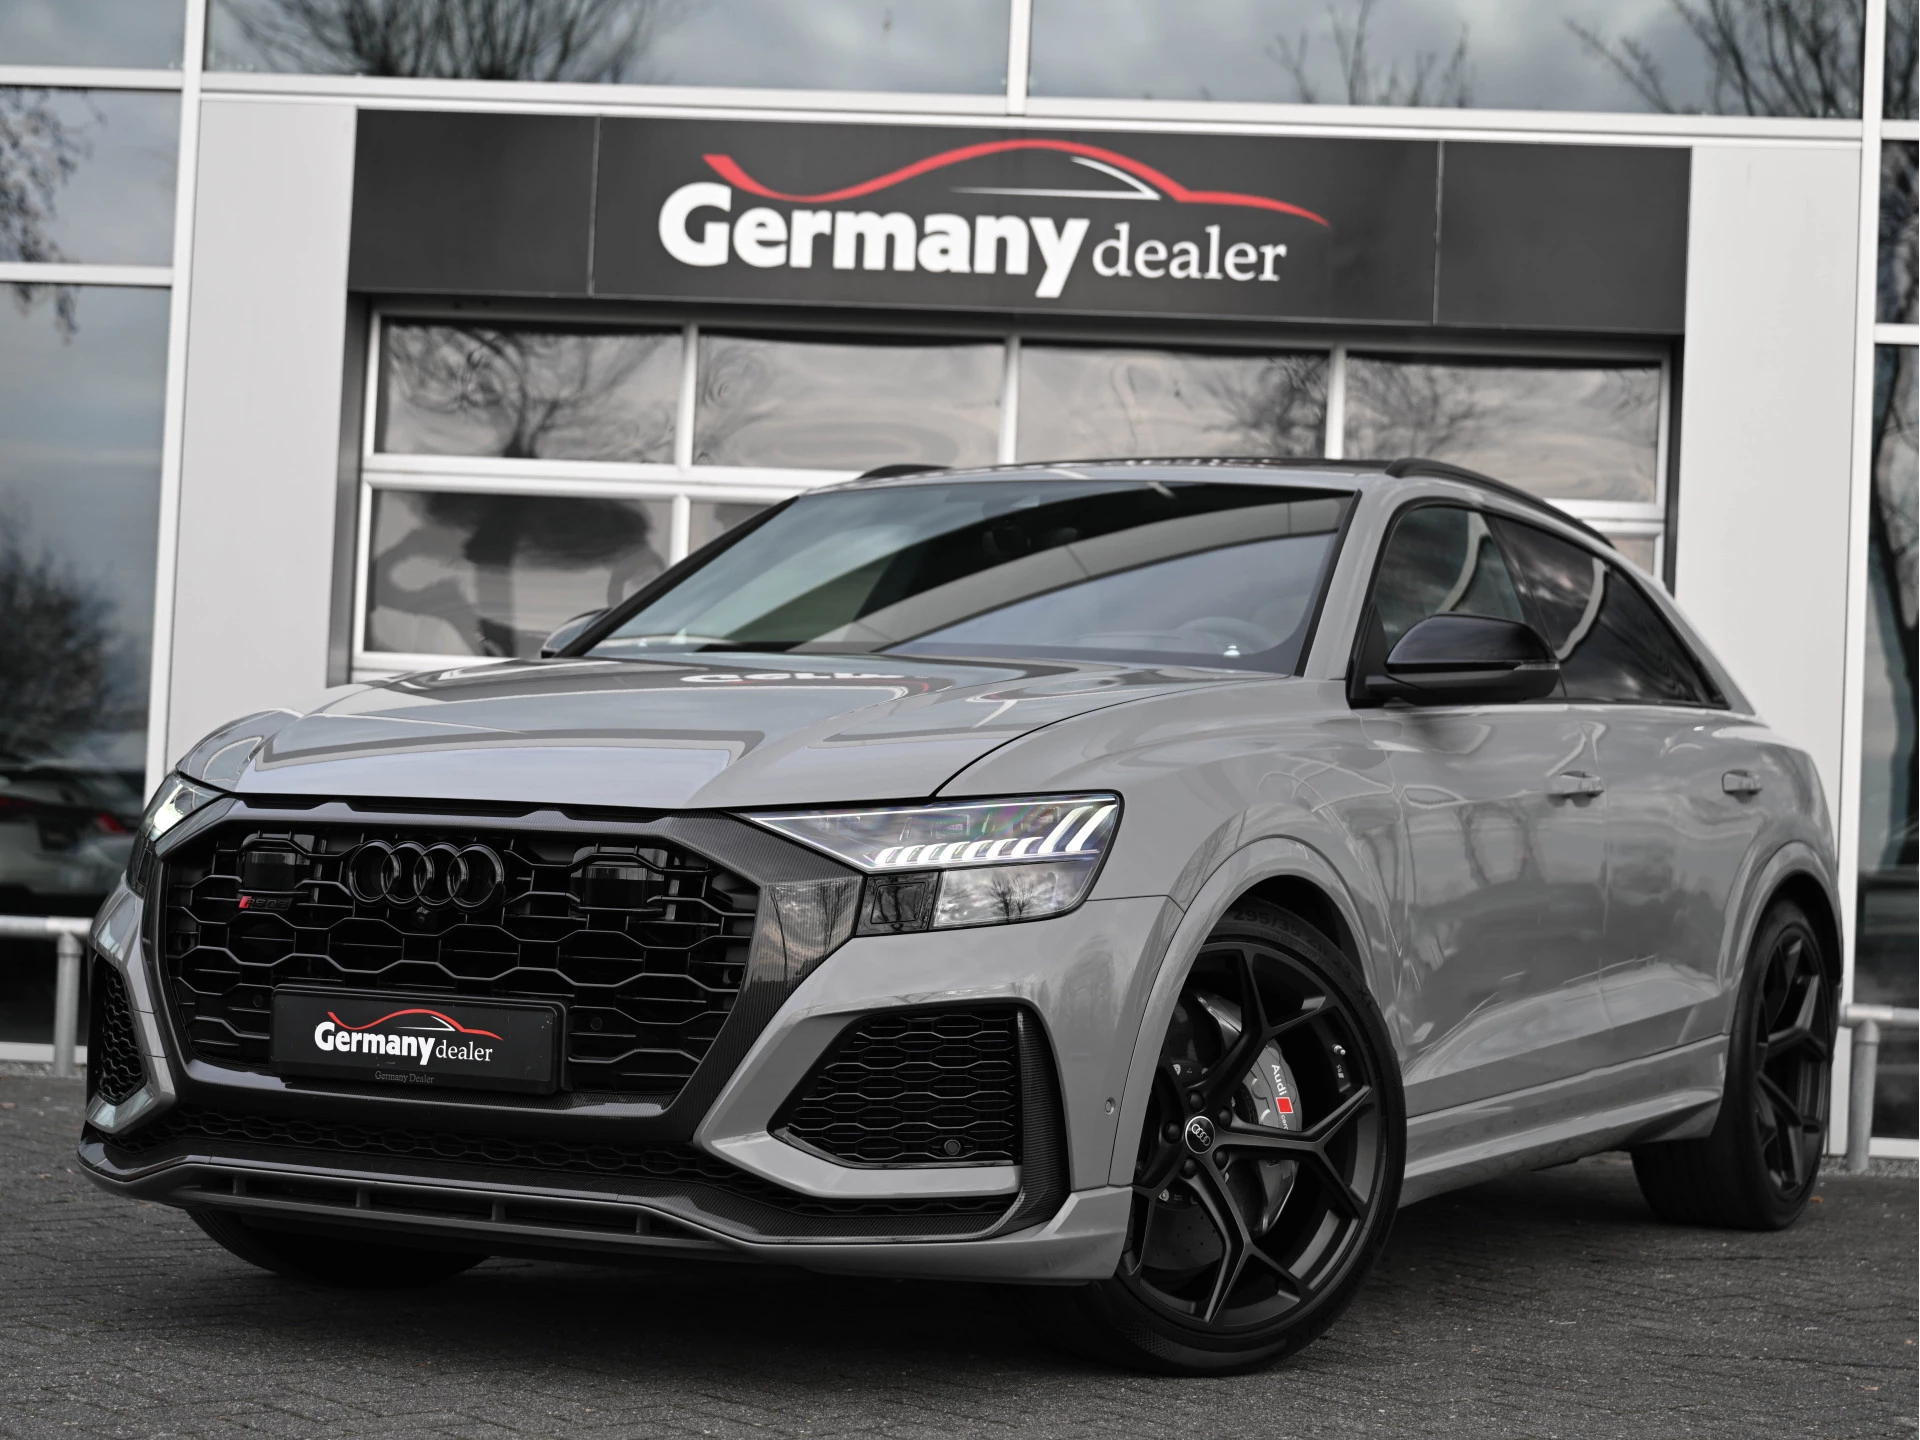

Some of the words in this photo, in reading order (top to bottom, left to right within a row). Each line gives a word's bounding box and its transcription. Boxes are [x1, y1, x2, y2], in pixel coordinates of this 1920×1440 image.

[658, 181, 1091, 299] Germany
[1092, 221, 1289, 282] dealer
[314, 1021, 436, 1066] Germany
[435, 1039, 494, 1062] dealer
[374, 1070, 409, 1083] Germany
[409, 1073, 435, 1084] Dealer
[1271, 1063, 1288, 1097] Audi
